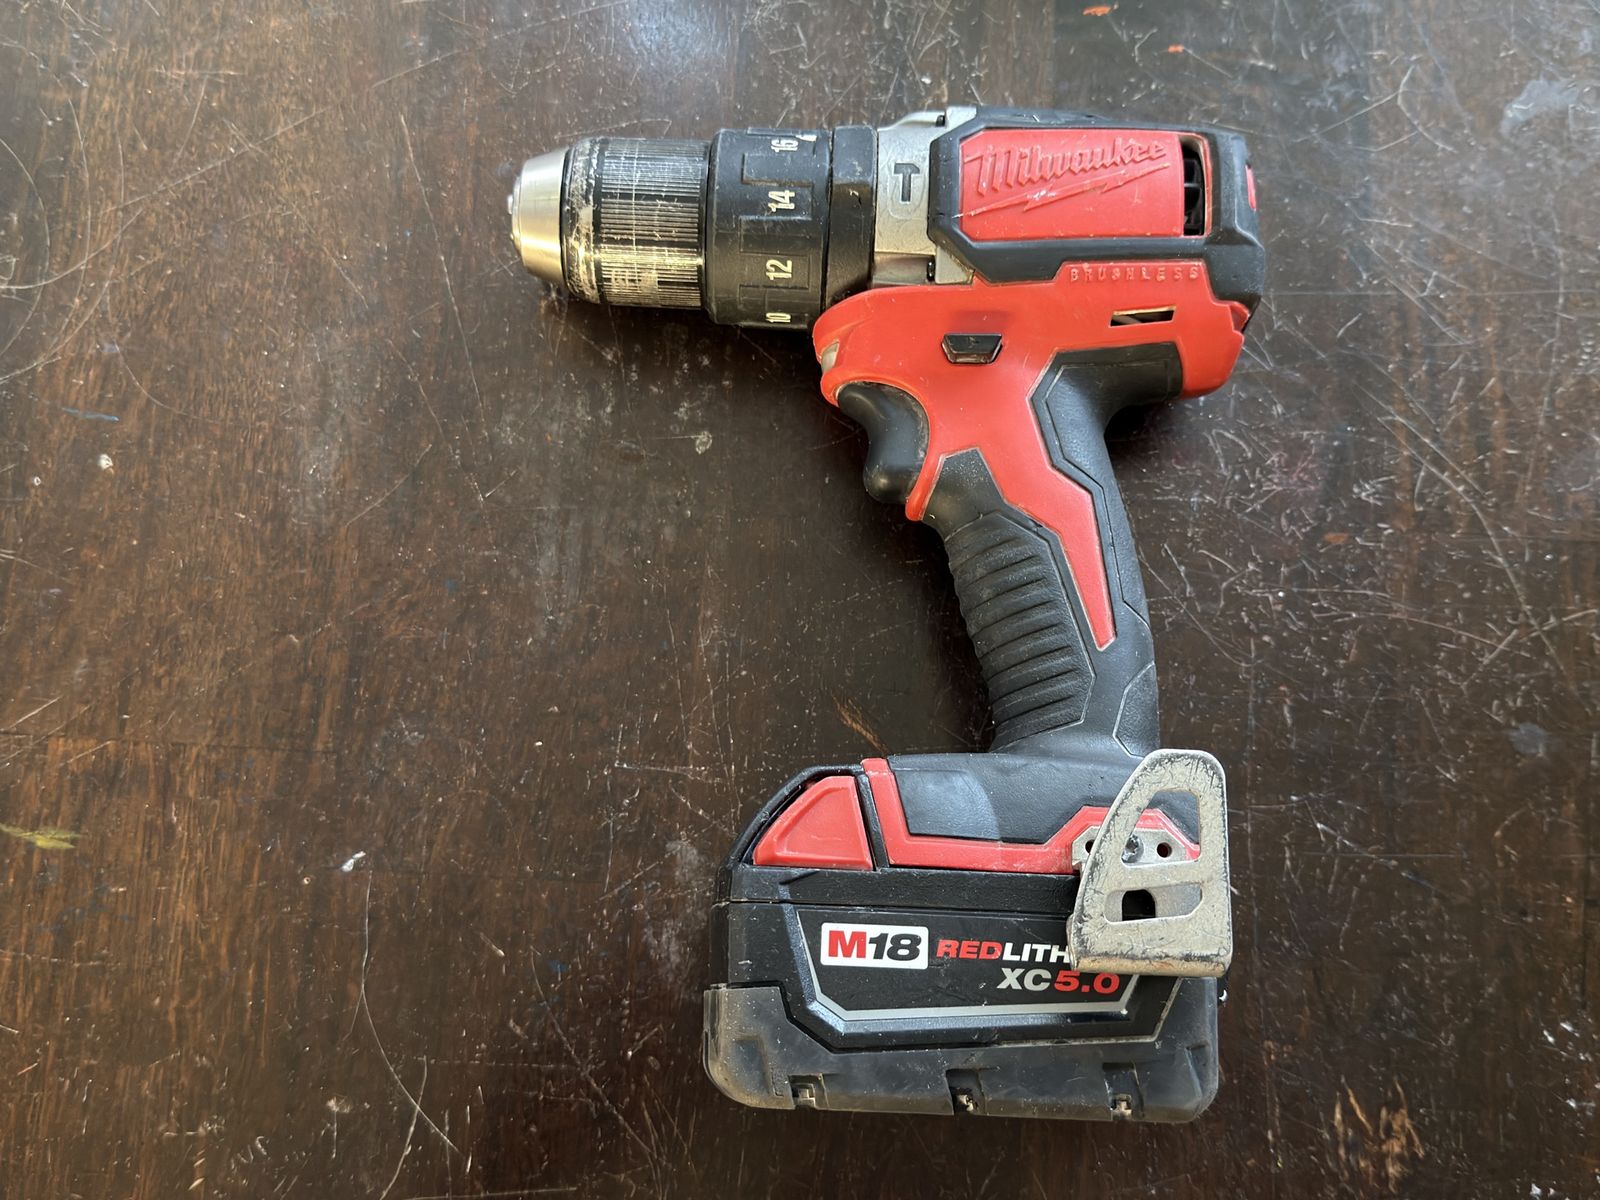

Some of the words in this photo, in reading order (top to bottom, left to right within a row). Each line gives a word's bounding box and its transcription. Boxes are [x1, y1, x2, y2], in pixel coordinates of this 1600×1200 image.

[770, 138, 799, 152] 16
[964, 136, 1168, 197] Milwaukee
[768, 189, 795, 212] 14
[766, 259, 793, 281] 12
[1070, 266, 1200, 281] BRUSHLESS
[765, 312, 792, 323] 10
[828, 930, 921, 961] M18
[936, 939, 1071, 963] REDLITH
